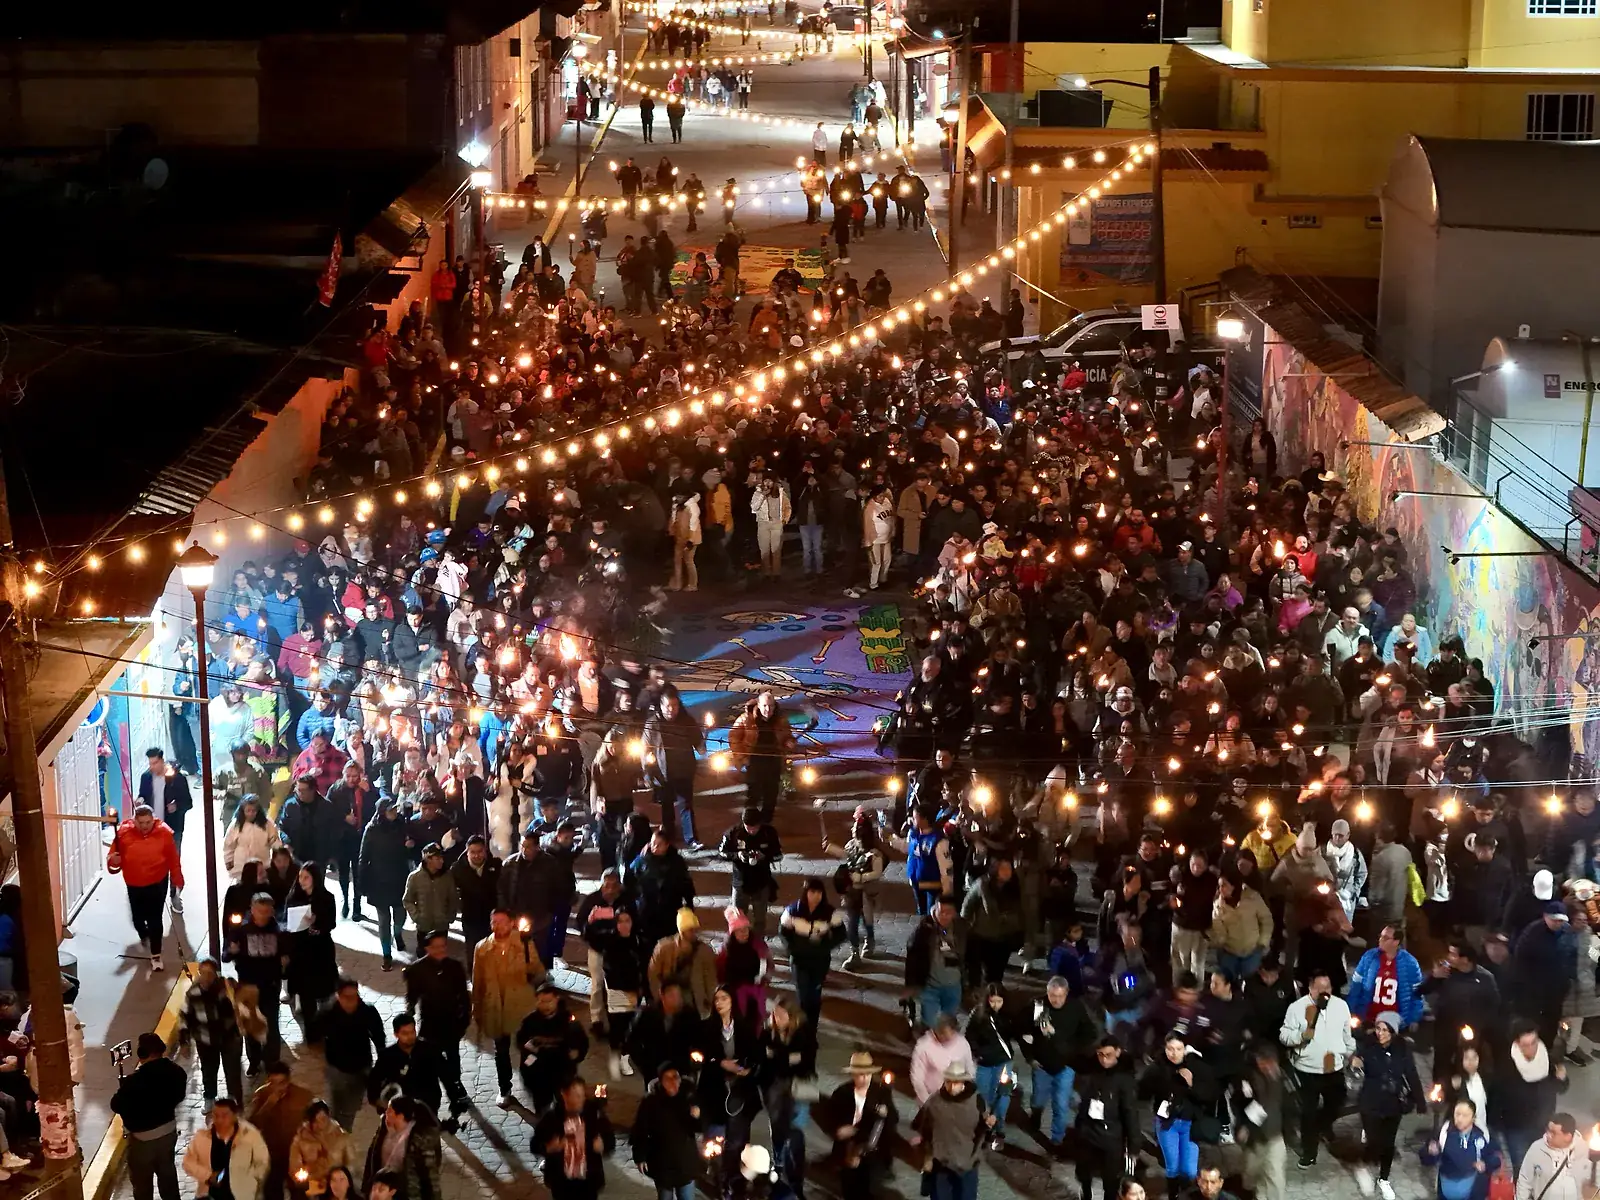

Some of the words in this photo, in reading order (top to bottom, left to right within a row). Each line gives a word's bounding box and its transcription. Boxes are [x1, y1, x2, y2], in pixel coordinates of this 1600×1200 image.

[1122, 198, 1154, 207] EXPRESS
[1097, 230, 1151, 241] PEDIDOS
[1085, 364, 1107, 383] ICÍA
[876, 509, 892, 520] YOR
[1373, 976, 1398, 1005] 13
